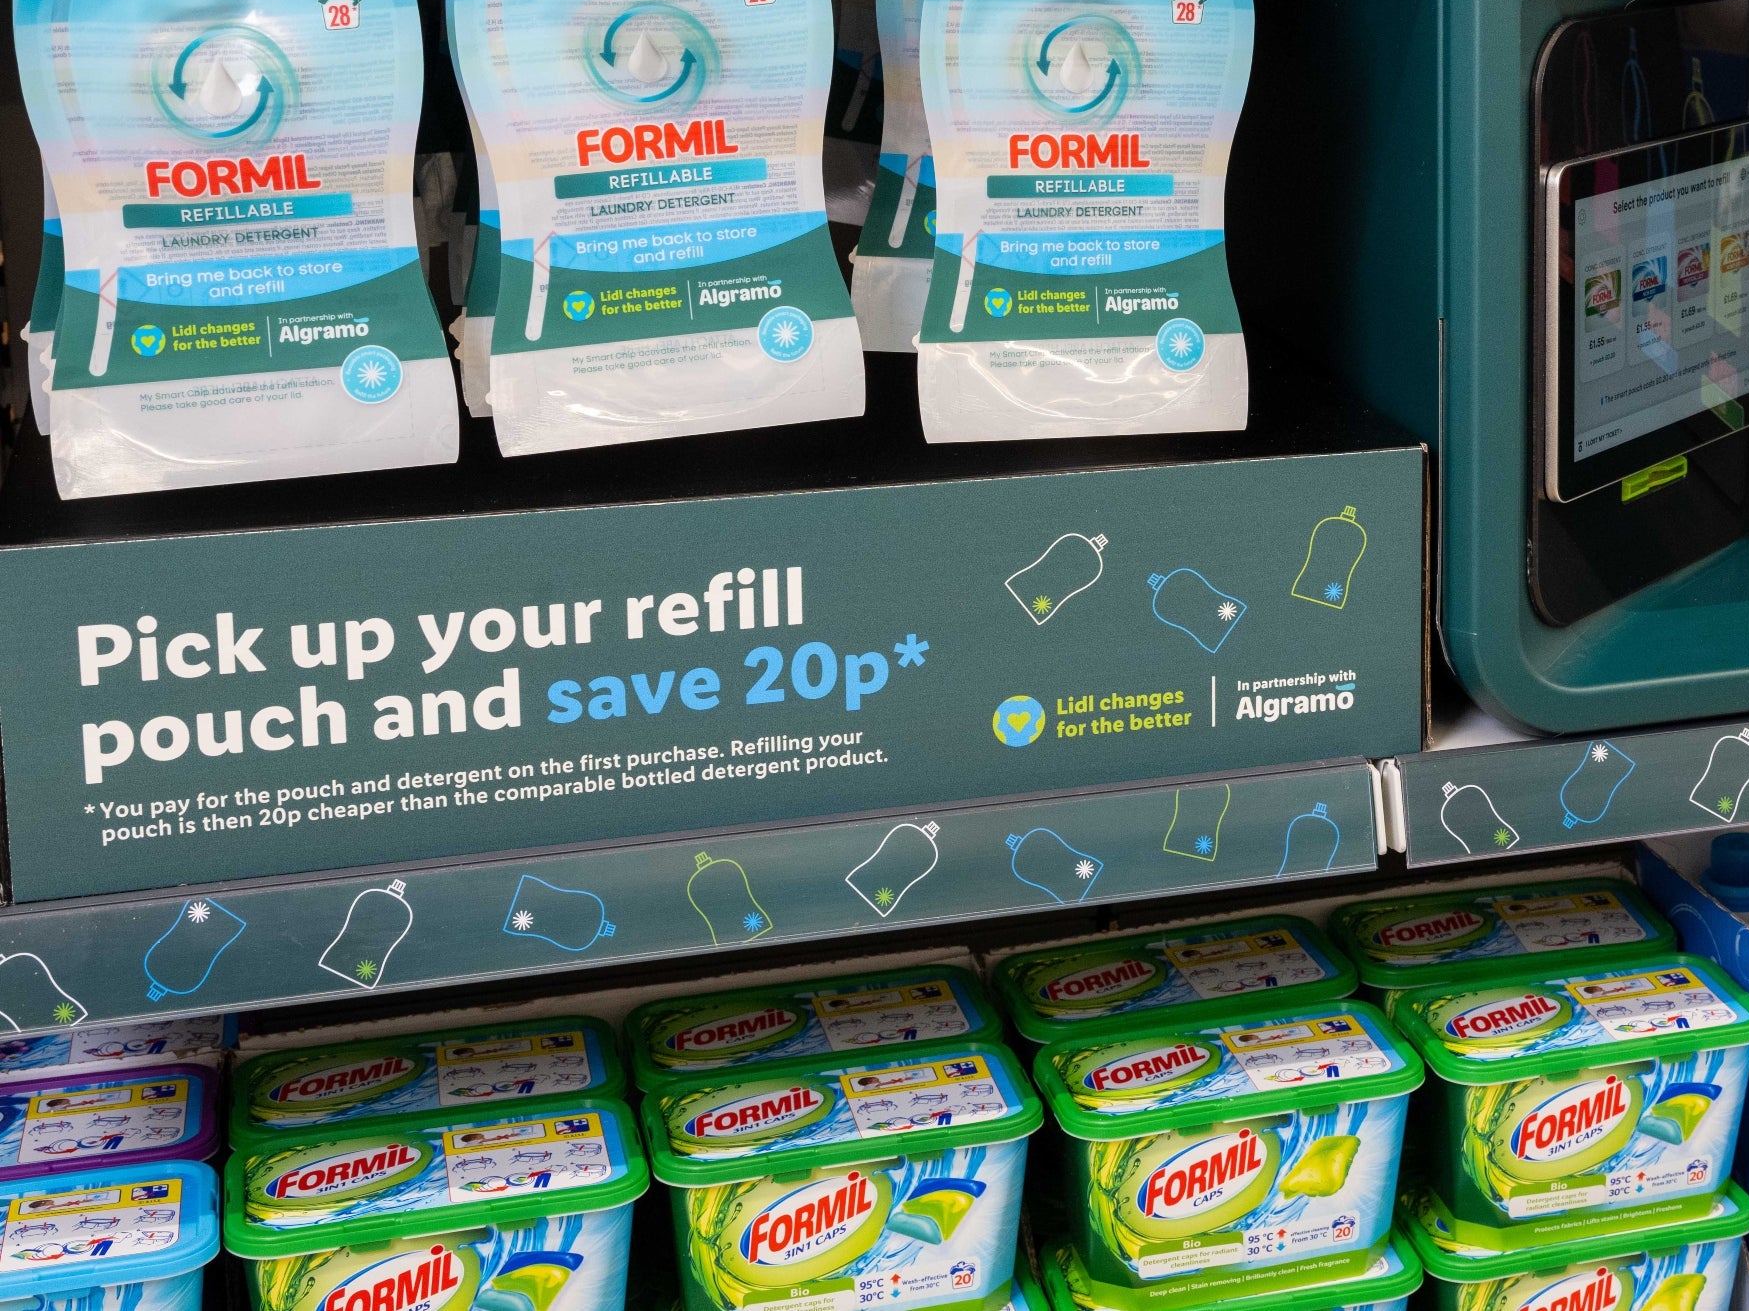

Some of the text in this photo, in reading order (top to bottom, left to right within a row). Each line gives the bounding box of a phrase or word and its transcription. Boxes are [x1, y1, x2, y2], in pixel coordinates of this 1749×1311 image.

[145, 154, 320, 198] FORMIL
[181, 201, 294, 223] REFILLABLE
[1613, 196, 1635, 214] Select
[1636, 195, 1648, 207] the
[1649, 189, 1676, 207] product
[78, 567, 802, 686] Pick up your refill
[1238, 670, 1355, 692] In partnership with
[1058, 691, 1184, 714] Lidl changes
[83, 686, 347, 784] pouch
[374, 668, 521, 740] and
[548, 668, 720, 723] save
[1057, 713, 1191, 737] for the better
[151, 799, 190, 818] pay
[197, 793, 228, 809] for
[235, 788, 269, 805] the
[278, 780, 344, 805] pouch
[352, 775, 390, 794] and
[398, 766, 502, 789] detergent
[509, 765, 533, 778] on
[540, 758, 573, 775] the
[580, 754, 620, 771] first
[628, 746, 724, 770] purchase.
[732, 735, 812, 756] Refilling
[819, 732, 862, 751] your
[103, 749, 888, 846] pouch is then 20p cheaper than the comparable bottled detergent product.
[1145, 1129, 1261, 1217] FORMIL
[1193, 1188, 1223, 1207] CAPS
